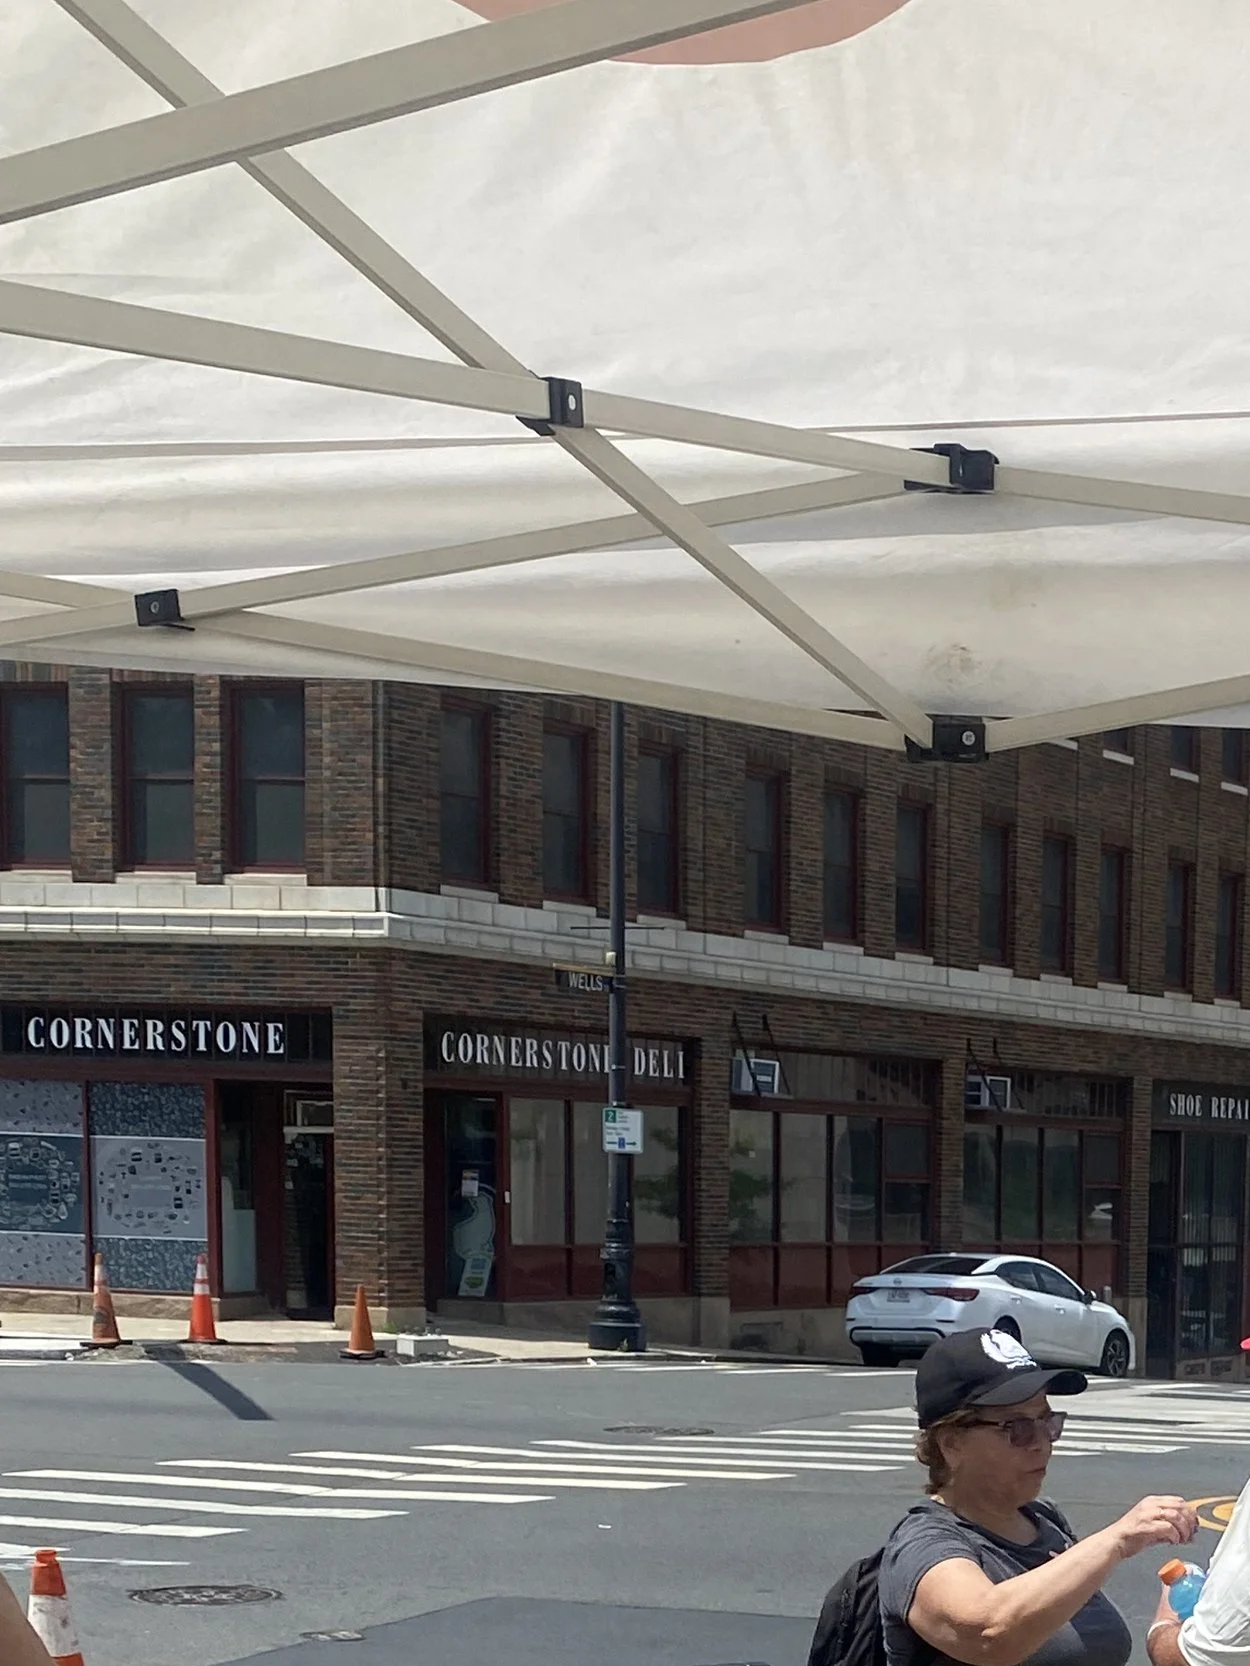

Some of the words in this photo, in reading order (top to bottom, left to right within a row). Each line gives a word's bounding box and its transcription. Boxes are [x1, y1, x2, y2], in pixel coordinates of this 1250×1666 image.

[568, 972, 603, 992] WELLS
[27, 1016, 285, 1054] CORNERSTONE
[634, 1047, 685, 1079] DELI
[1169, 1093, 1202, 1117] SHOE
